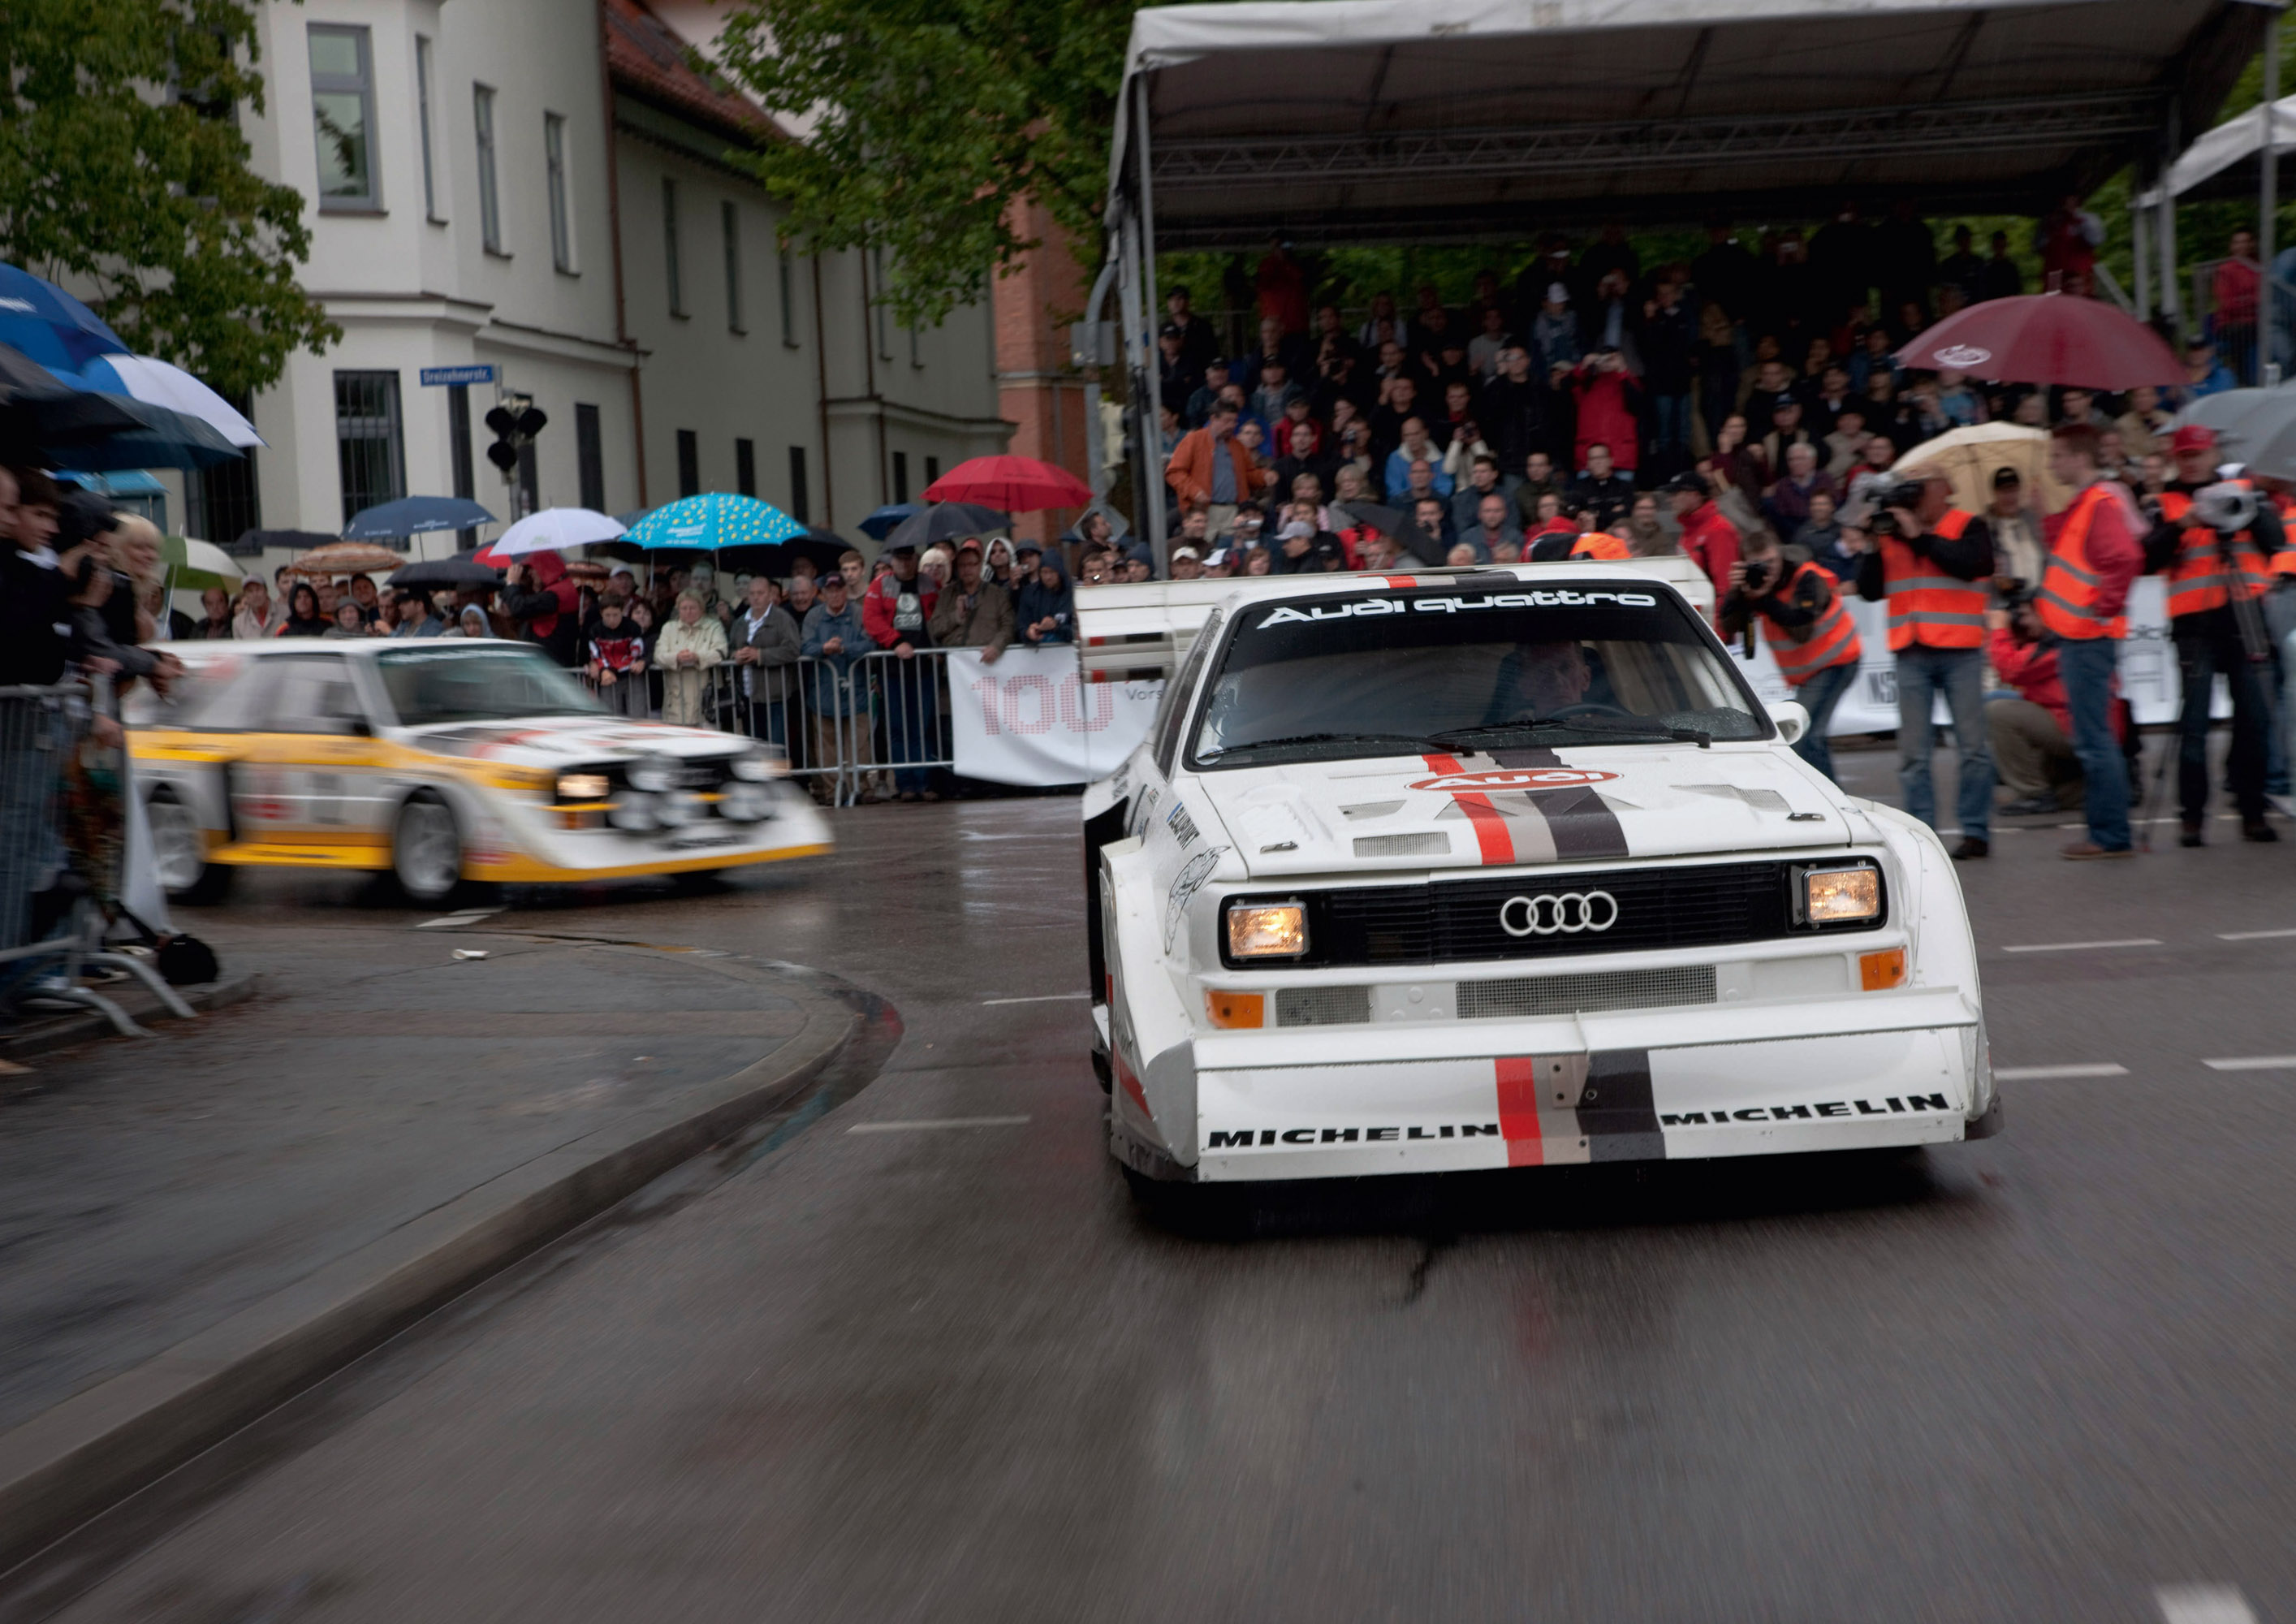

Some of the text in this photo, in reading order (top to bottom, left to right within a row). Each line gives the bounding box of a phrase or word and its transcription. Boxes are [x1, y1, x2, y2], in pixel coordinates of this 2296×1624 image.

[1257, 590, 1656, 630] Audi quattro
[971, 672, 1115, 735] 100
[1124, 688, 1164, 701] Vors
[1426, 771, 1605, 788] Audi
[1660, 1093, 1950, 1126] MICHELIN
[1207, 1123, 1500, 1149] MICHELIN
